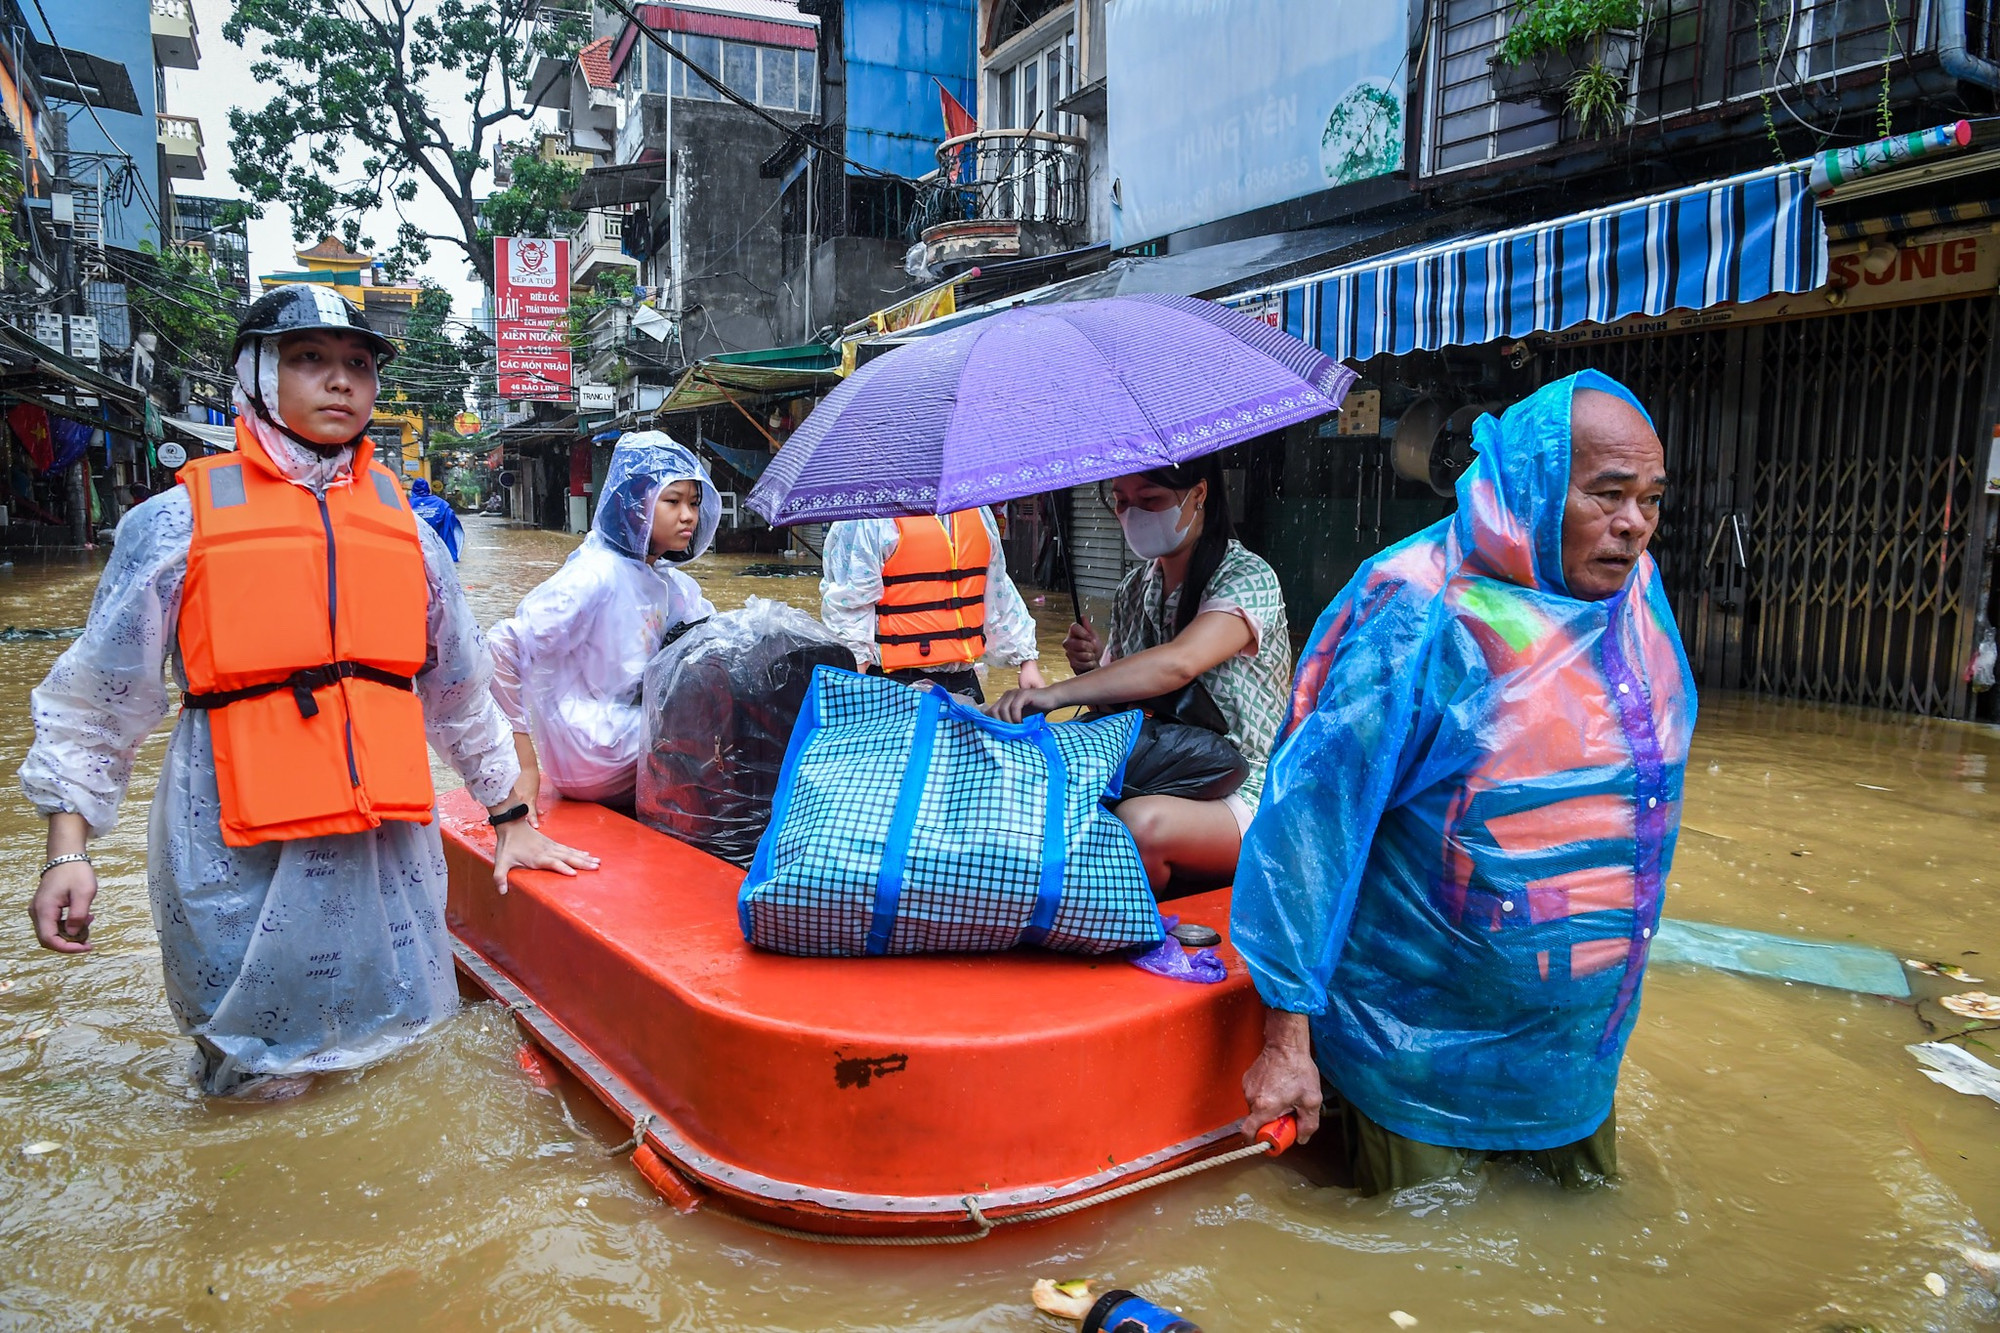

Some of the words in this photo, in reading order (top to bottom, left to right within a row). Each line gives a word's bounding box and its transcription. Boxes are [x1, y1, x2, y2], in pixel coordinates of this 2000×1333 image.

[548, 291, 560, 302] ỐC
[525, 304, 540, 314] THÁI
[1592, 323, 1624, 339] BẢO
[1629, 320, 1668, 334] LINH
[500, 359, 520, 369] CÁC
[521, 359, 542, 370] MÓN
[544, 361, 569, 372] NHẬU
[540, 384, 559, 392] LINH
[582, 392, 604, 401] TRANG
[604, 392, 612, 401] LY
